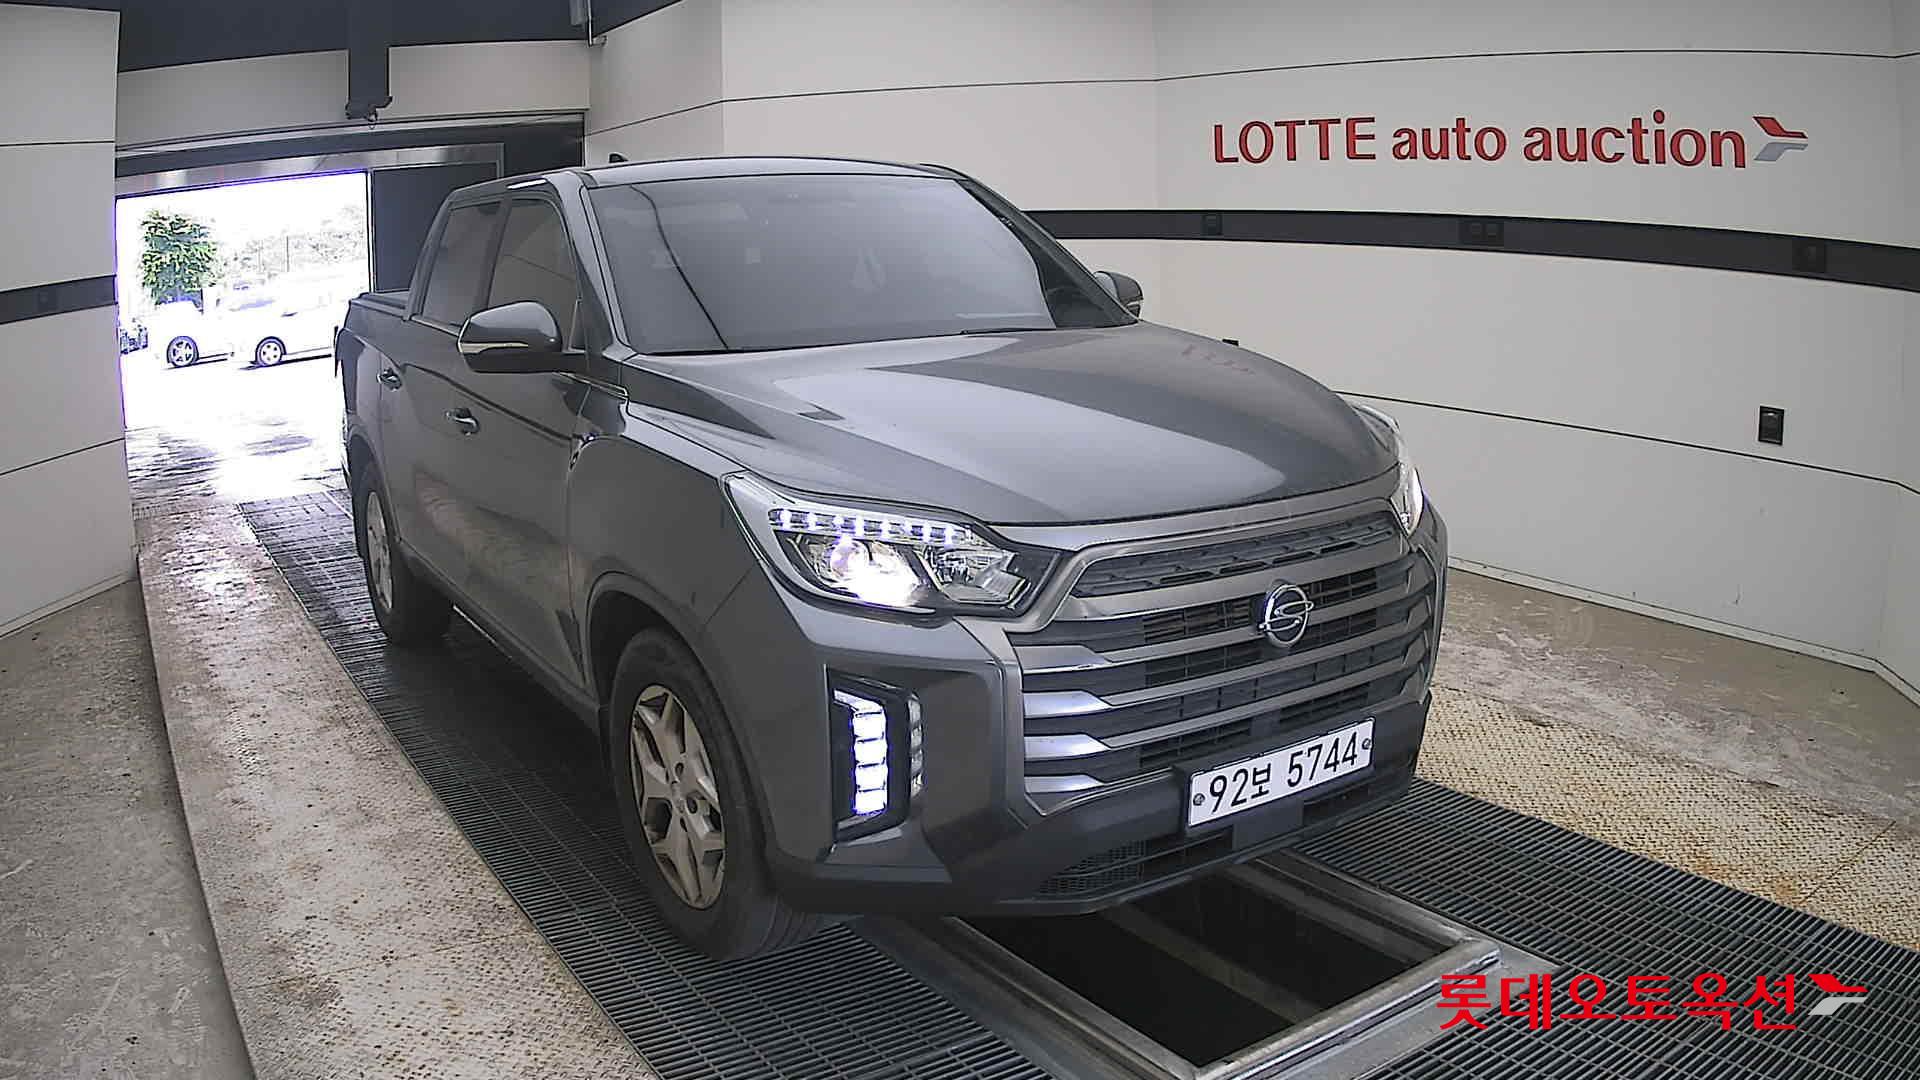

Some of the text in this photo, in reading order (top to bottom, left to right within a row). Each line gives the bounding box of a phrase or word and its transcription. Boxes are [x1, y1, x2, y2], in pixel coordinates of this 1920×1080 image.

[1213, 110, 1747, 169] LOTTE auto auction
[1209, 731, 1358, 814] 92보 5744
